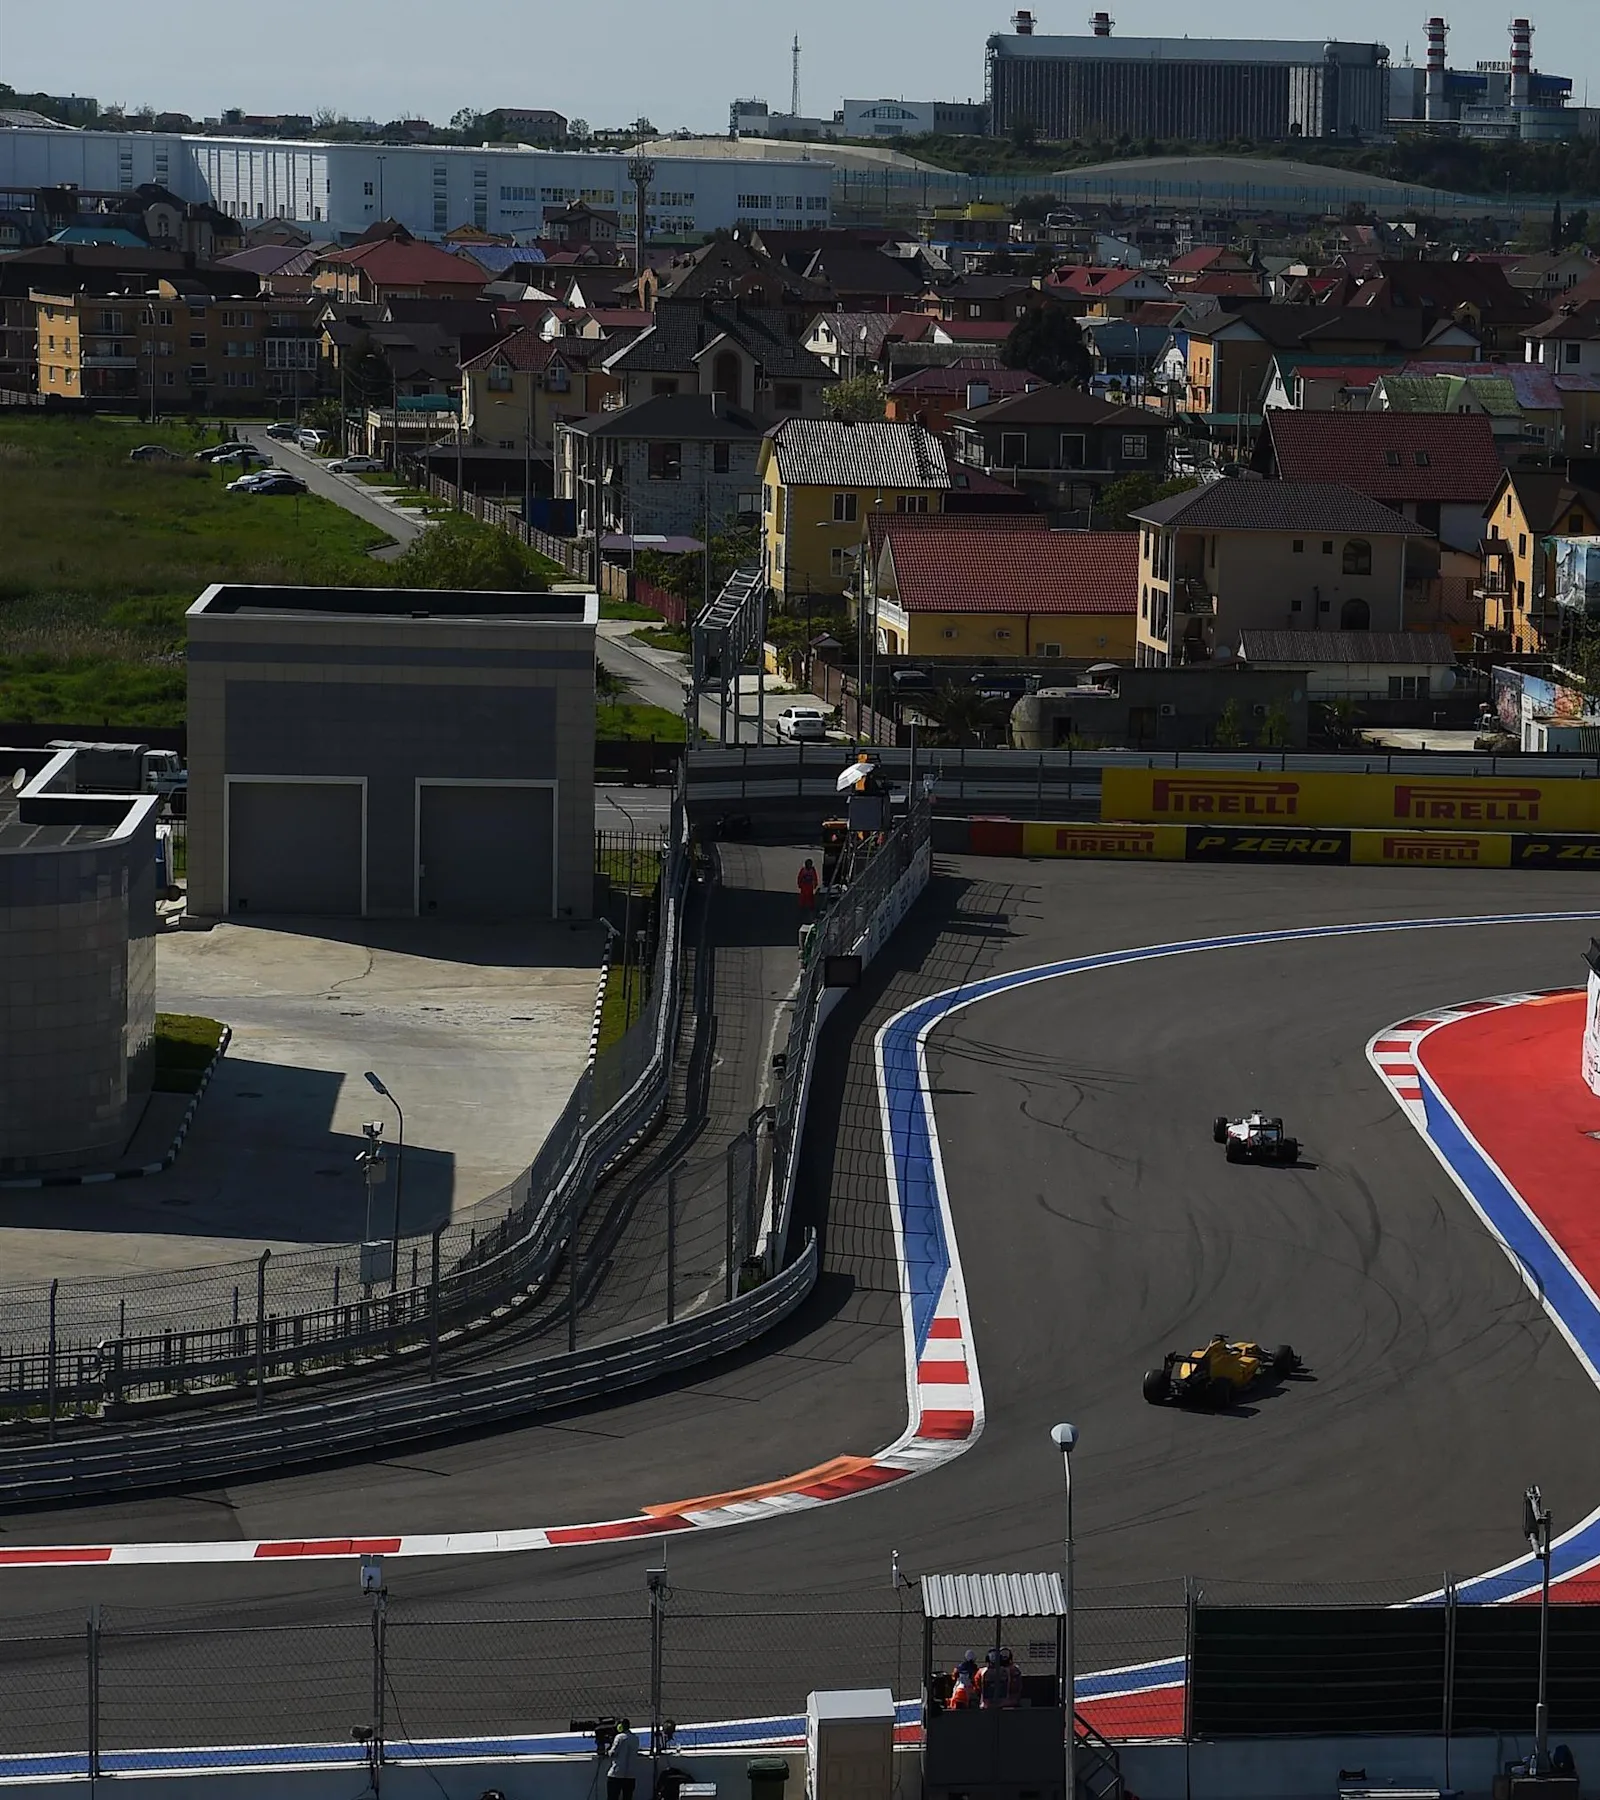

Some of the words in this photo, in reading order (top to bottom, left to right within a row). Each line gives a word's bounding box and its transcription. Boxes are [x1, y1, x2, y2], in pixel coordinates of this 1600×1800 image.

[1152, 779, 1300, 815] PIRELLI
[1395, 785, 1542, 821] PIRELLI
[1056, 829, 1155, 853] PIRELLI
[1197, 836, 1228, 852] P
[1233, 836, 1343, 854] ZERO
[1383, 838, 1480, 862] PIRELLI
[1522, 844, 1550, 858] P
